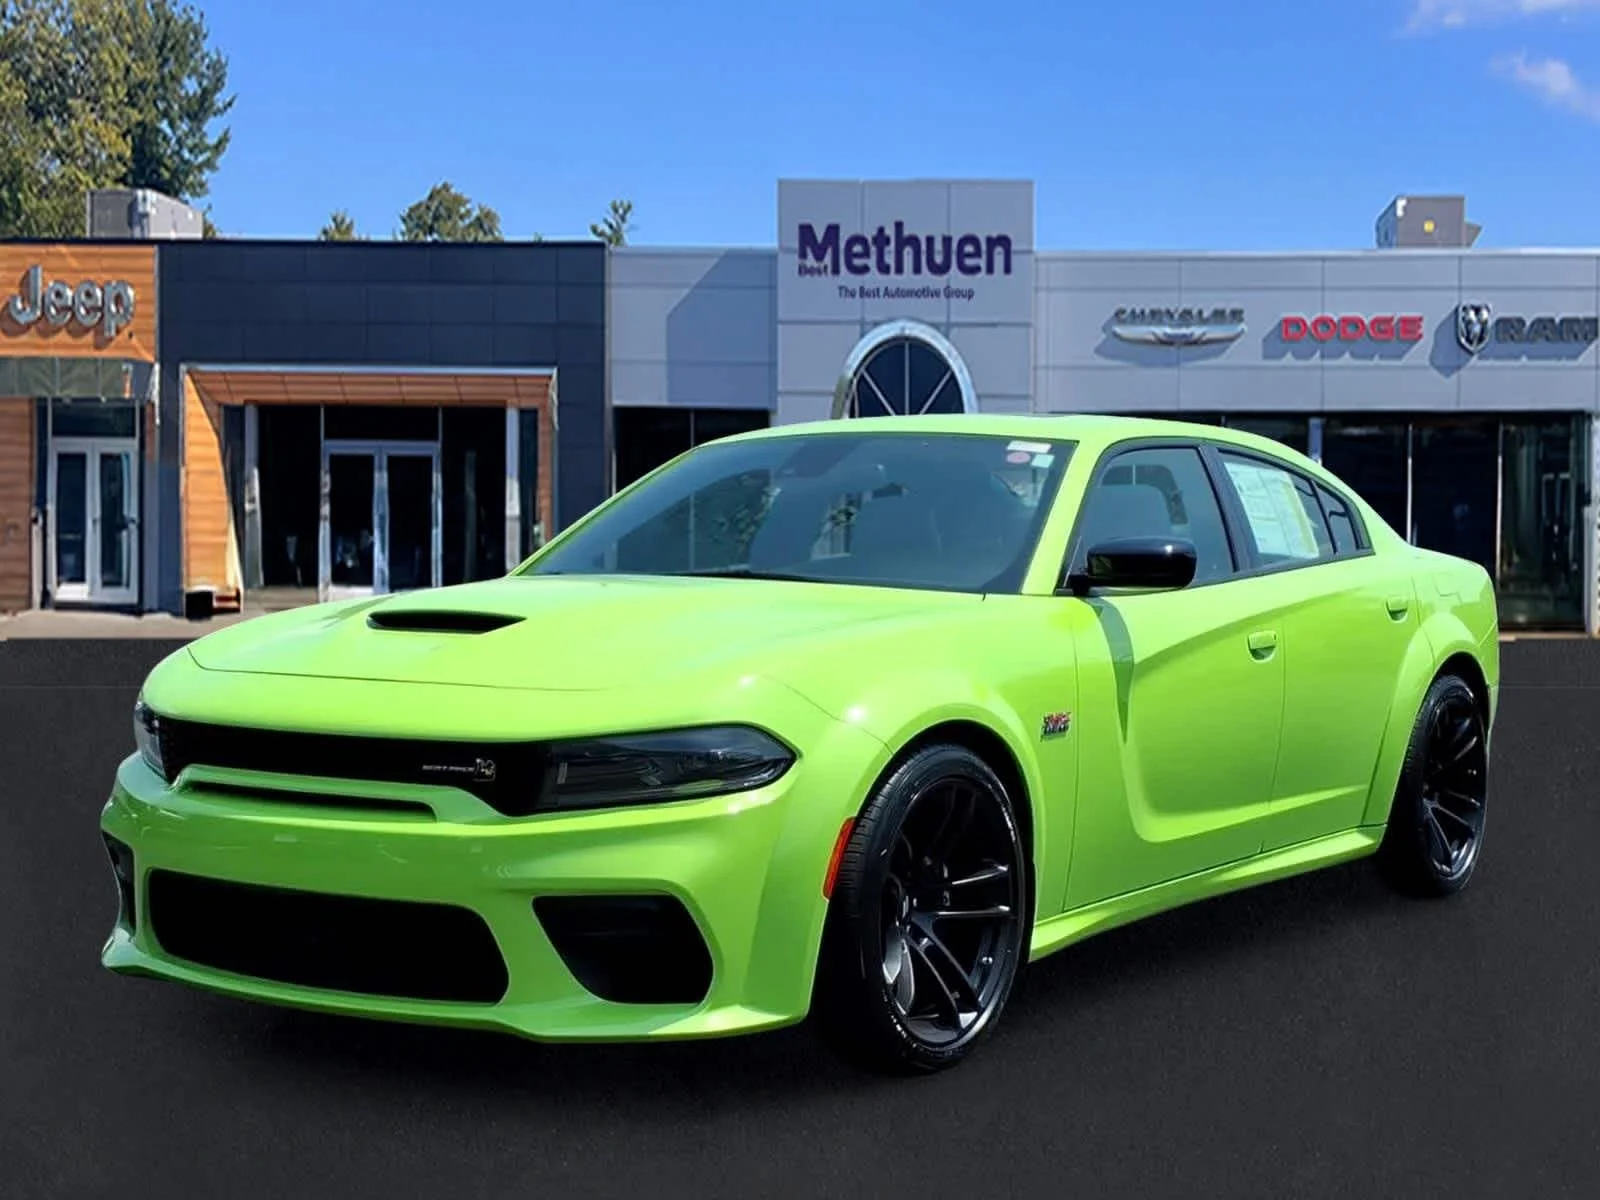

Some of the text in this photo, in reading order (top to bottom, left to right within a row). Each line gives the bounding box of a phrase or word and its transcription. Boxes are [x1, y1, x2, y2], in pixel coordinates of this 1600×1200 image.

[798, 220, 1012, 276] Methuen
[9, 264, 134, 337] Jeep
[838, 286, 975, 301] The Best Automotive Group
[1114, 307, 1245, 323] CHRYSLER
[1281, 316, 1423, 341] DODGE
[1494, 317, 1599, 343] RAM
